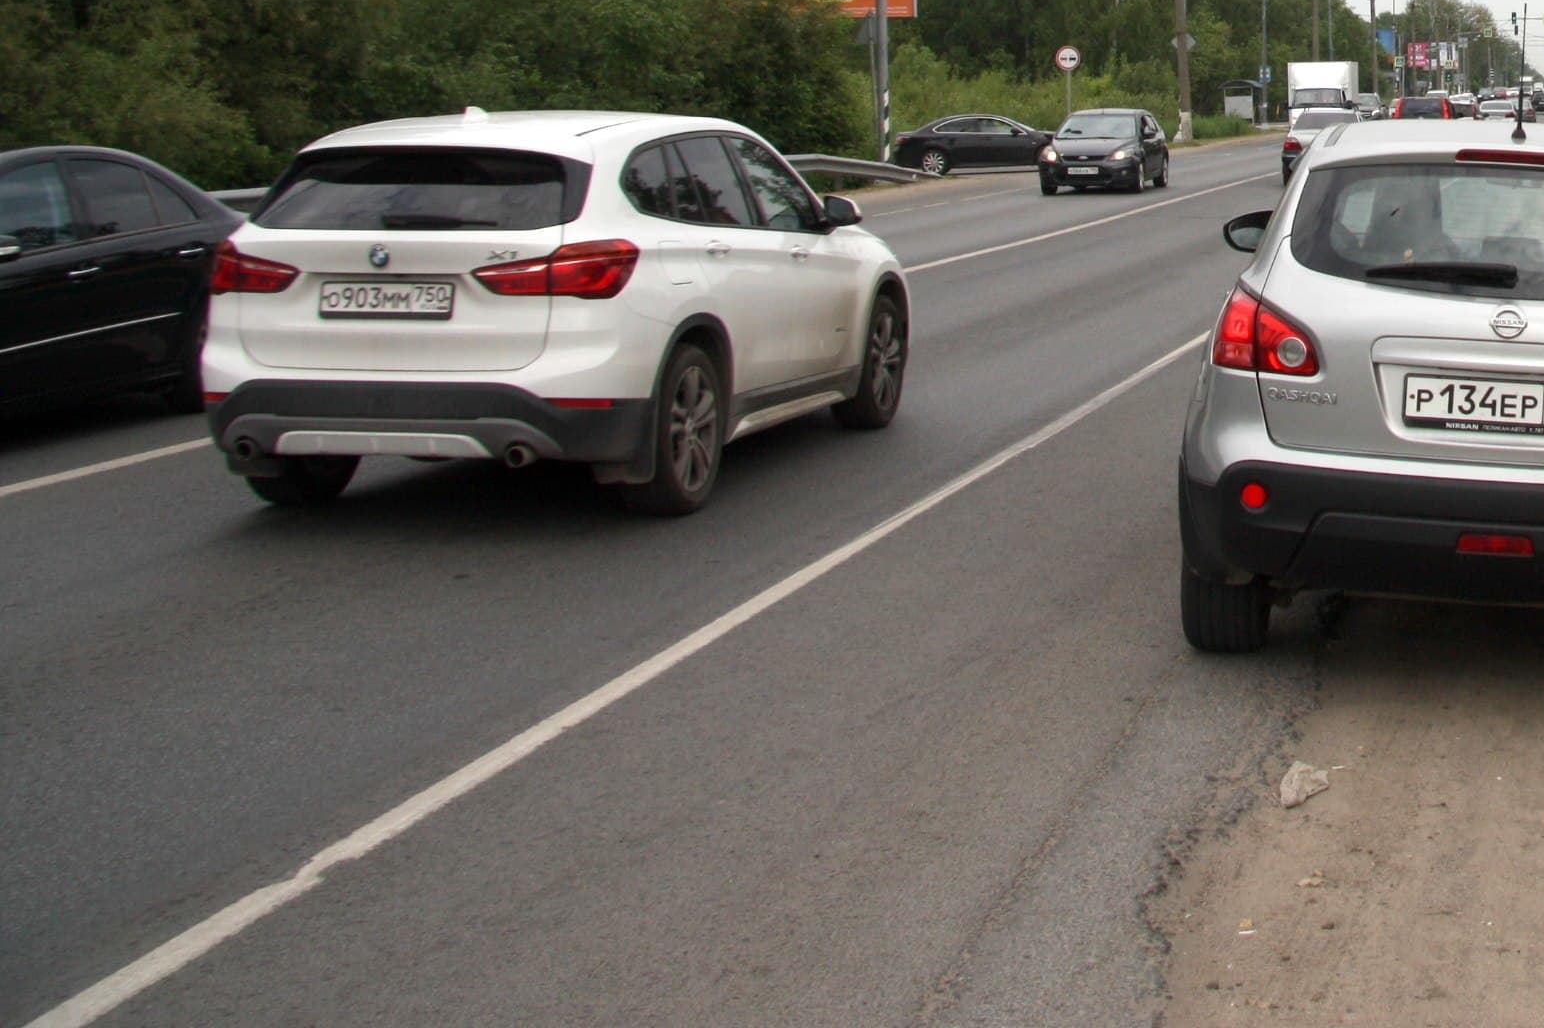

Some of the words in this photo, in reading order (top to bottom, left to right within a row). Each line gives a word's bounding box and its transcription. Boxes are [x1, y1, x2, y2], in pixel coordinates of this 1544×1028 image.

[413, 285, 448, 303] 750
[1492, 318, 1527, 327] NISSAN
[1266, 386, 1338, 406] QASHQAI
[1445, 421, 1480, 431] NISSAN
